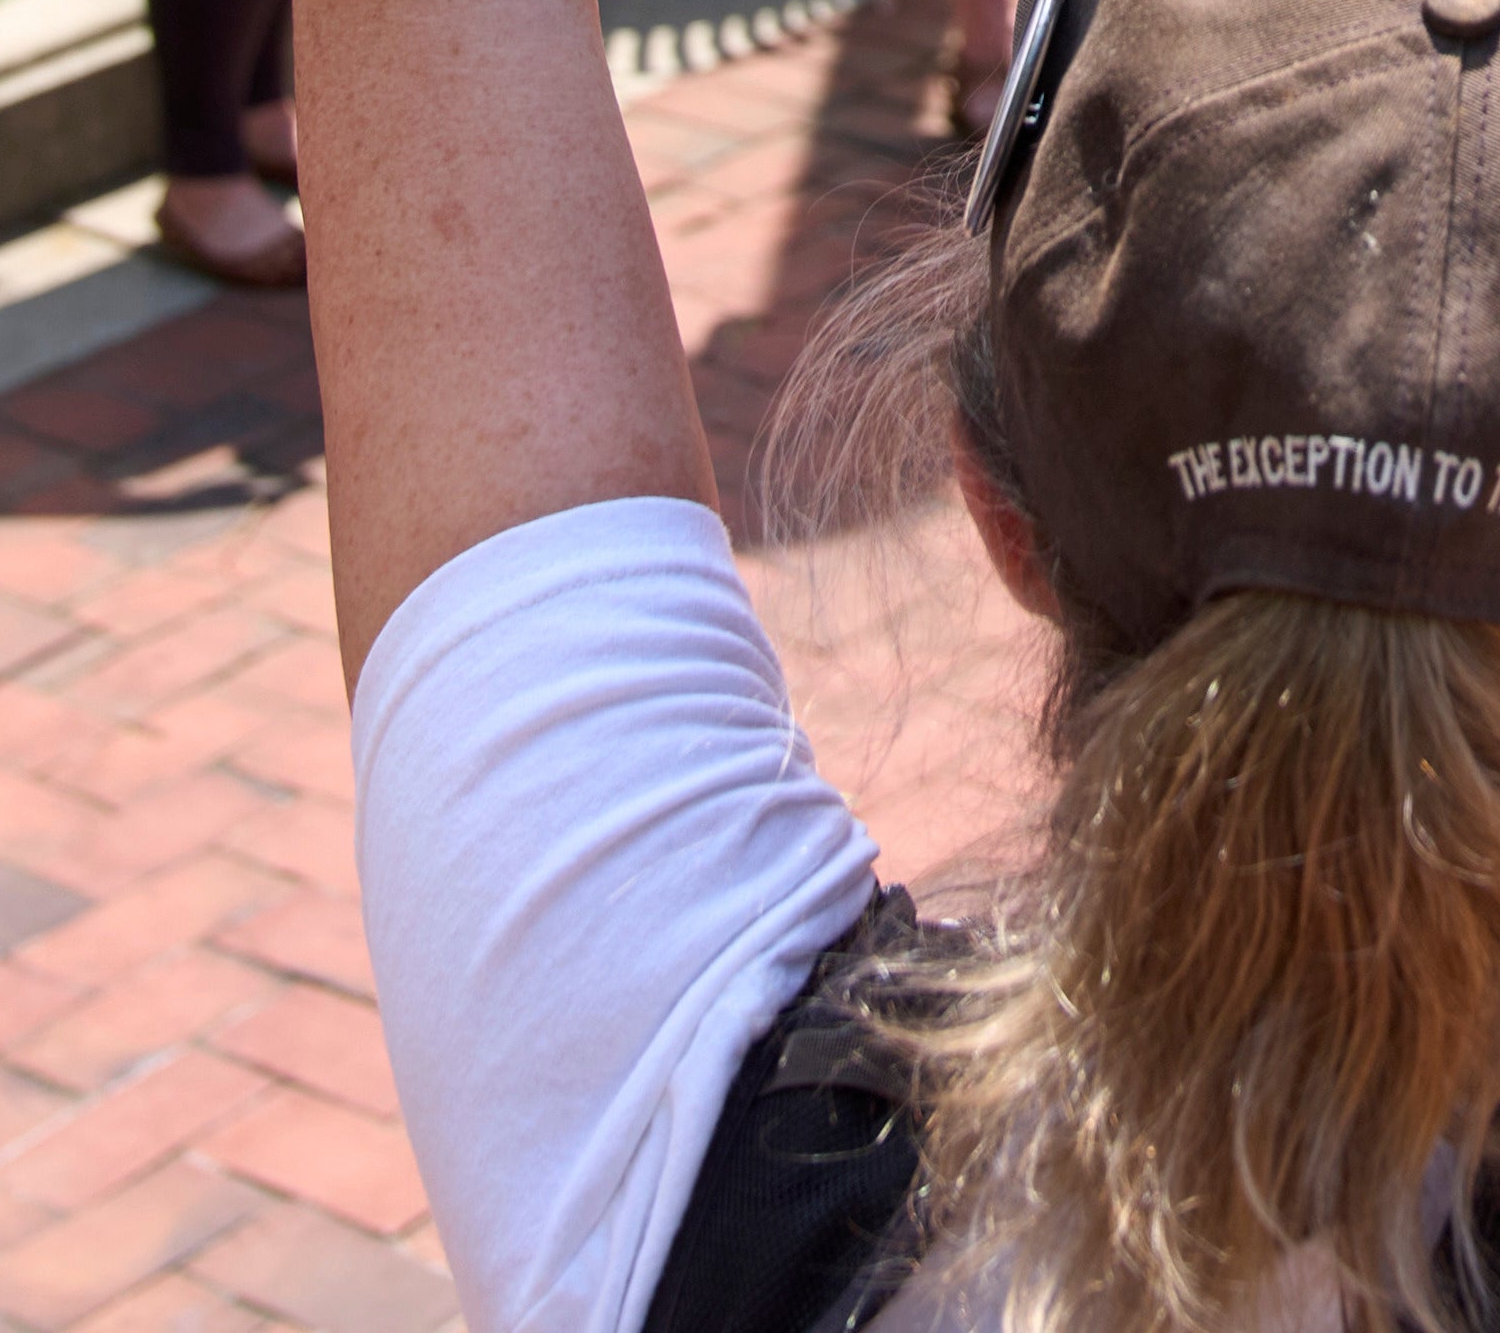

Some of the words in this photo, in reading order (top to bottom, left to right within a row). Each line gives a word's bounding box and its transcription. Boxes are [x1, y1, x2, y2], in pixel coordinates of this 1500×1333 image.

[1168, 439, 1226, 501] THE
[1228, 433, 1423, 504] EXCEPTION
[1431, 450, 1483, 509] TO
